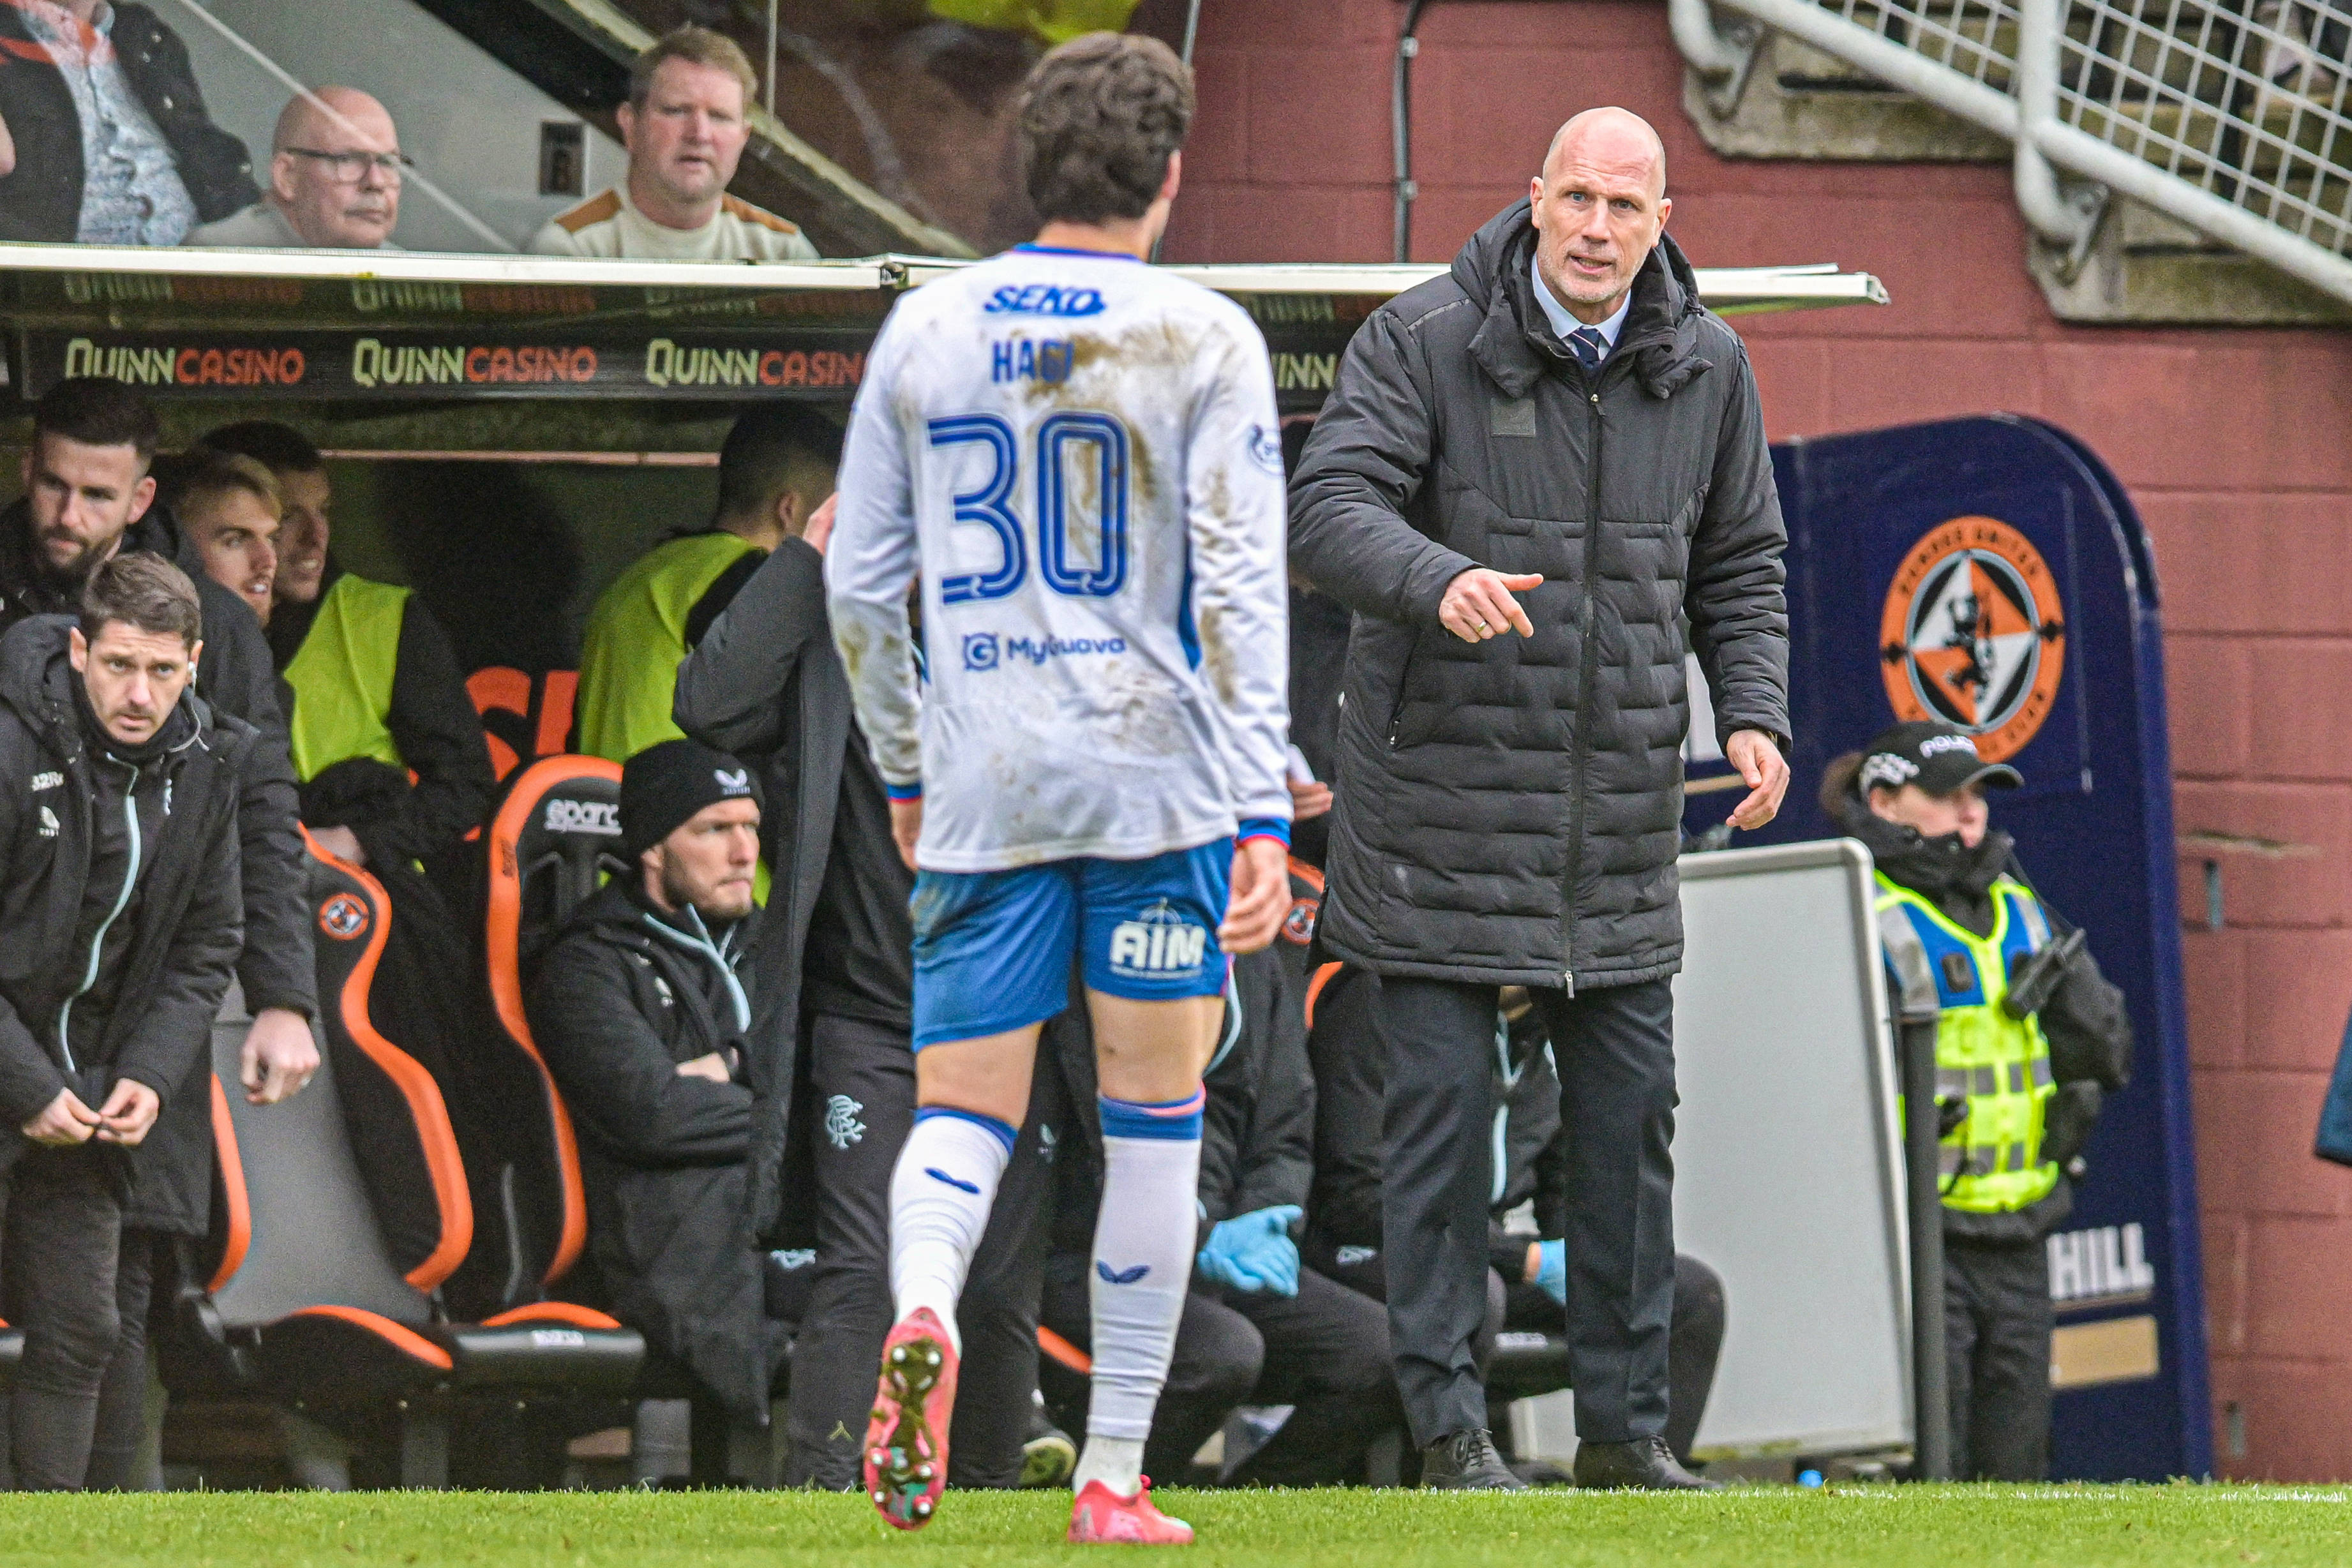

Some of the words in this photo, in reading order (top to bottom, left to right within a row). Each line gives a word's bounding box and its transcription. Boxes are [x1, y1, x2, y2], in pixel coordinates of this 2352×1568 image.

[646, 339, 867, 387] QUINNCASIN
[928, 412, 1129, 604] 30
[1109, 920, 1206, 971] AIM
[2046, 1223, 2155, 1299] HILL
